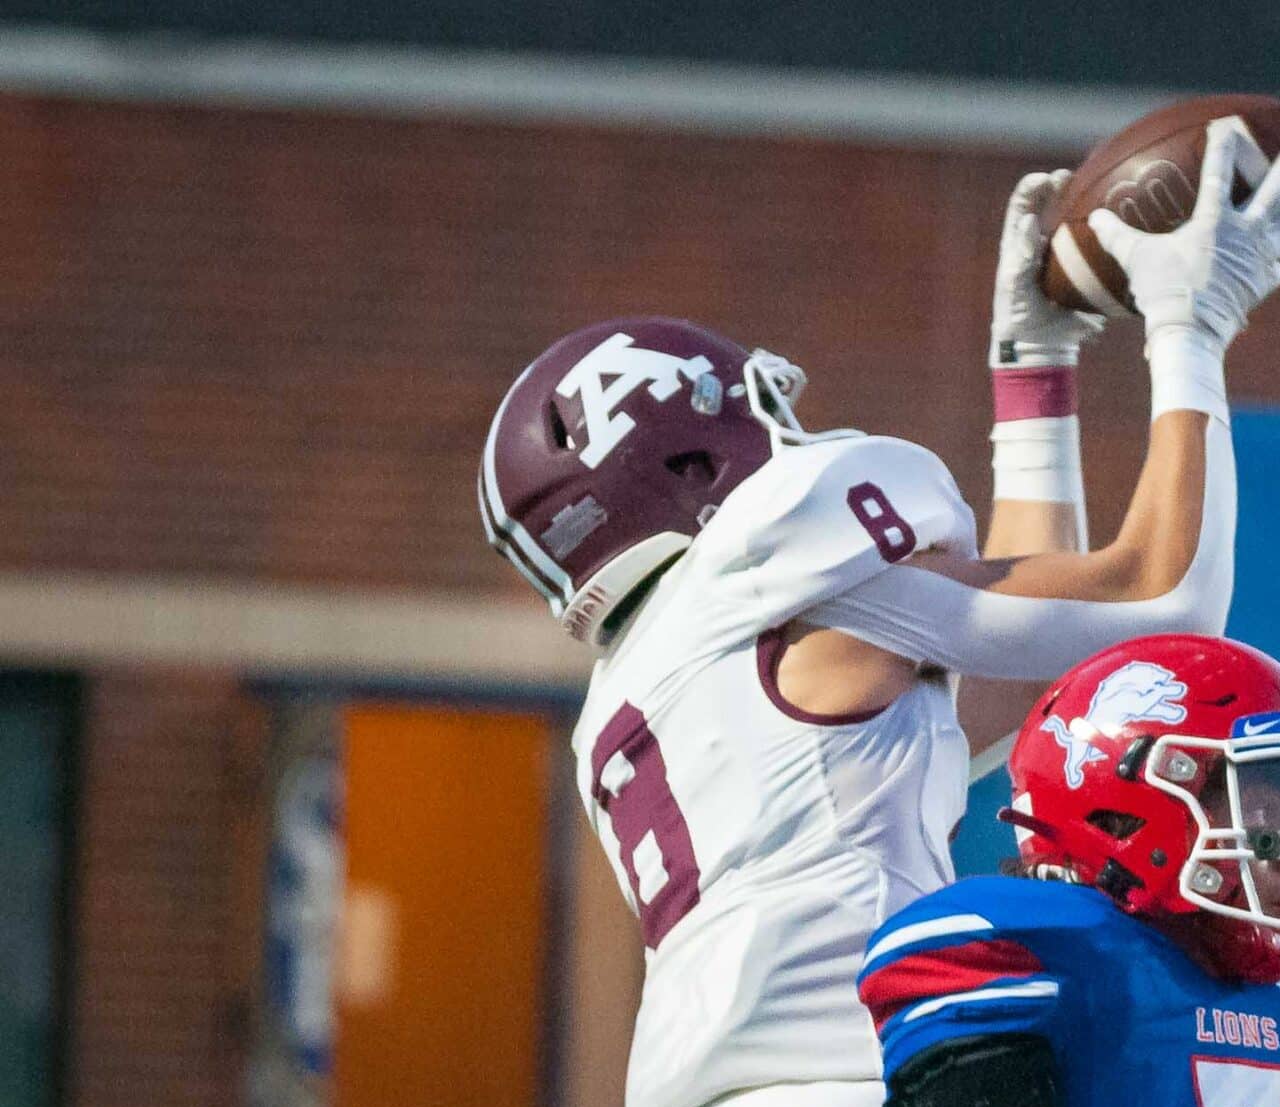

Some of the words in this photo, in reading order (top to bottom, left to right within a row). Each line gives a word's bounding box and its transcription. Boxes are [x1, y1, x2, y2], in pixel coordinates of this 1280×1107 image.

[556, 332, 714, 470] A
[846, 481, 917, 563] 8
[591, 698, 701, 952] 8
[1195, 1007, 1280, 1050] LIONS
